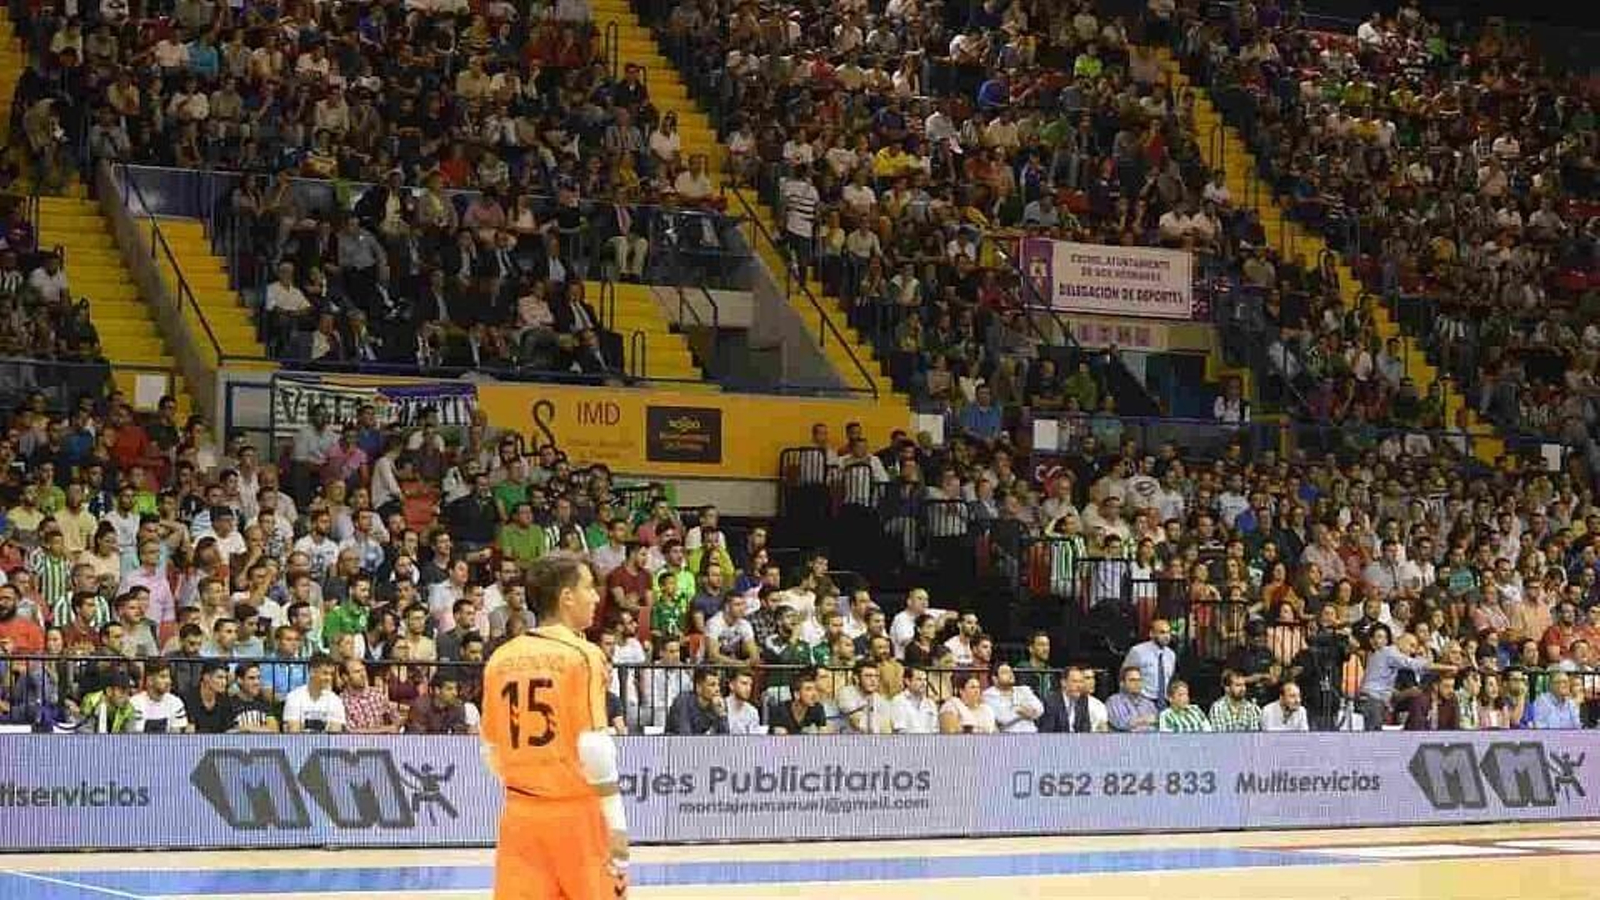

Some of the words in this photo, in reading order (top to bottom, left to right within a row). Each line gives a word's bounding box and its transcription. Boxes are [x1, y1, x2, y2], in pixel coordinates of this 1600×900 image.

[1121, 288, 1135, 301] DE
[577, 401, 620, 426] IMD
[501, 679, 556, 749] 15
[619, 766, 696, 802] ajes
[709, 765, 931, 793] Publicitarios
[1039, 772, 1092, 797] 652
[1103, 772, 1156, 796] 824
[1165, 770, 1217, 795] 833
[1236, 769, 1381, 793] Multiservicios
